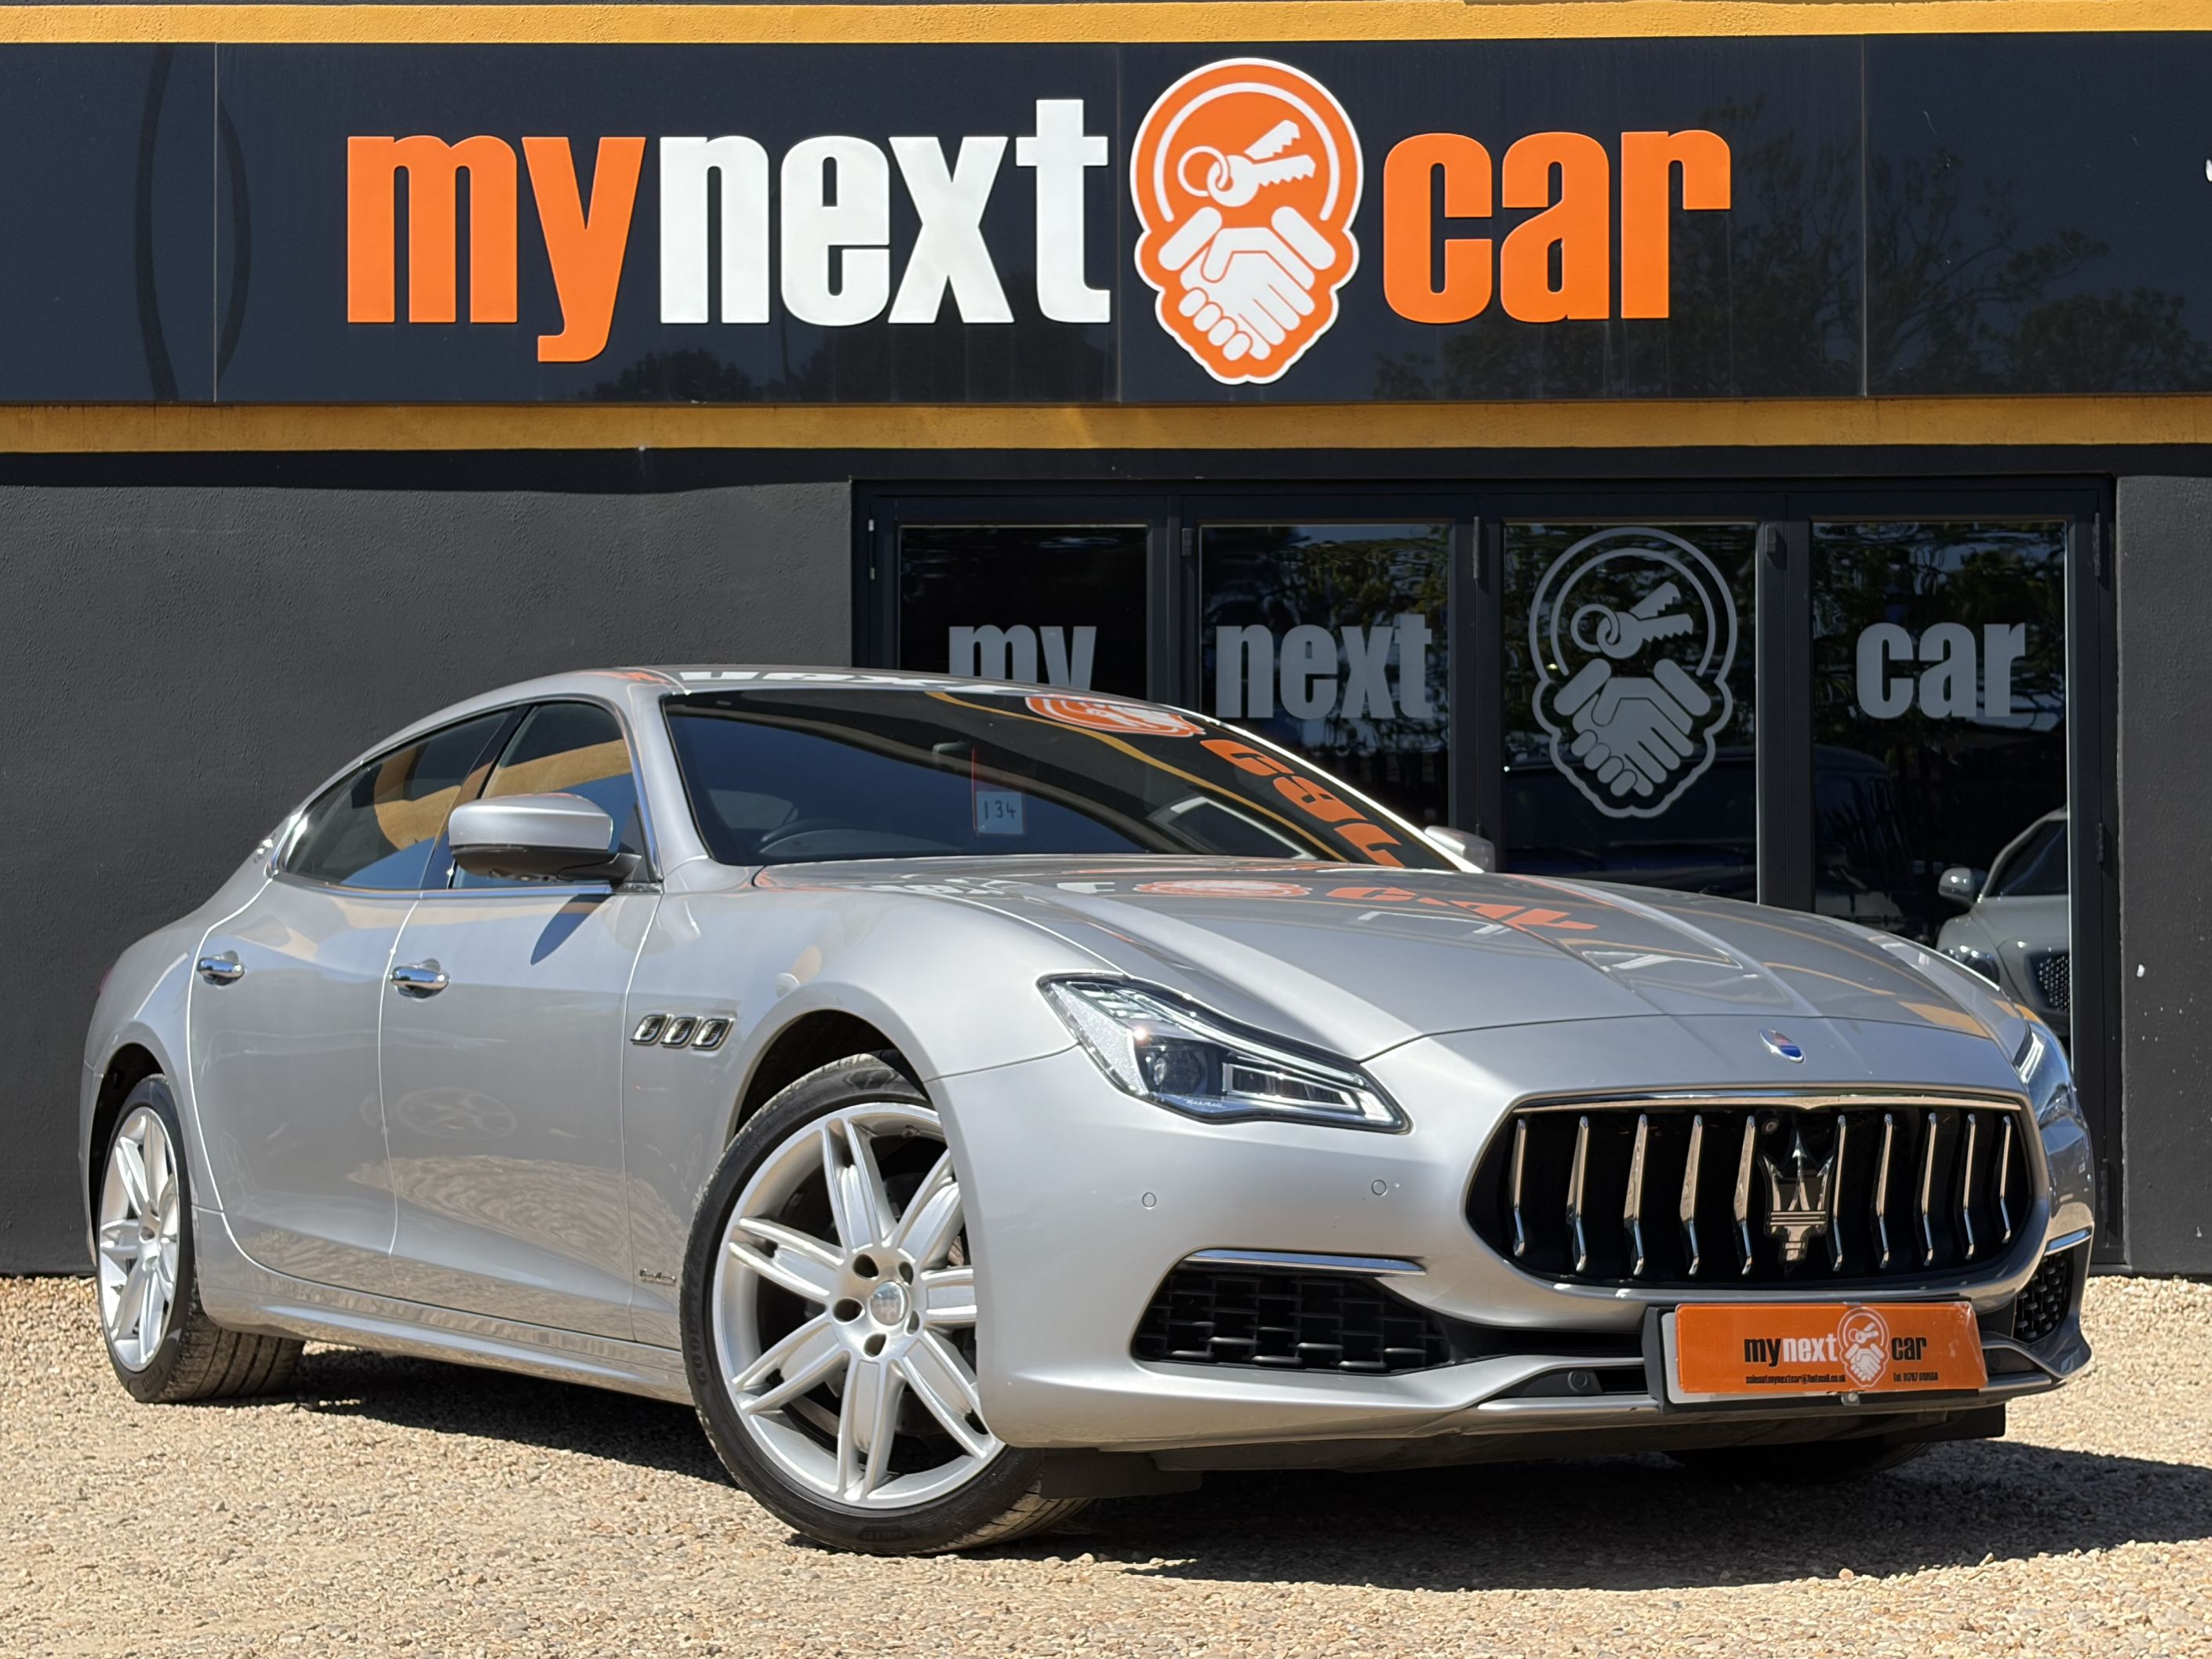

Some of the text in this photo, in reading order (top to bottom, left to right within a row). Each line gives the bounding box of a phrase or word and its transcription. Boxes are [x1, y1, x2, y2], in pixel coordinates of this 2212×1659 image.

[1383, 129, 1731, 324] car
[1217, 613, 1432, 719] next
[1856, 622, 2026, 719] car
[984, 799, 1017, 820] 134
[1891, 1336, 1927, 1362] car
